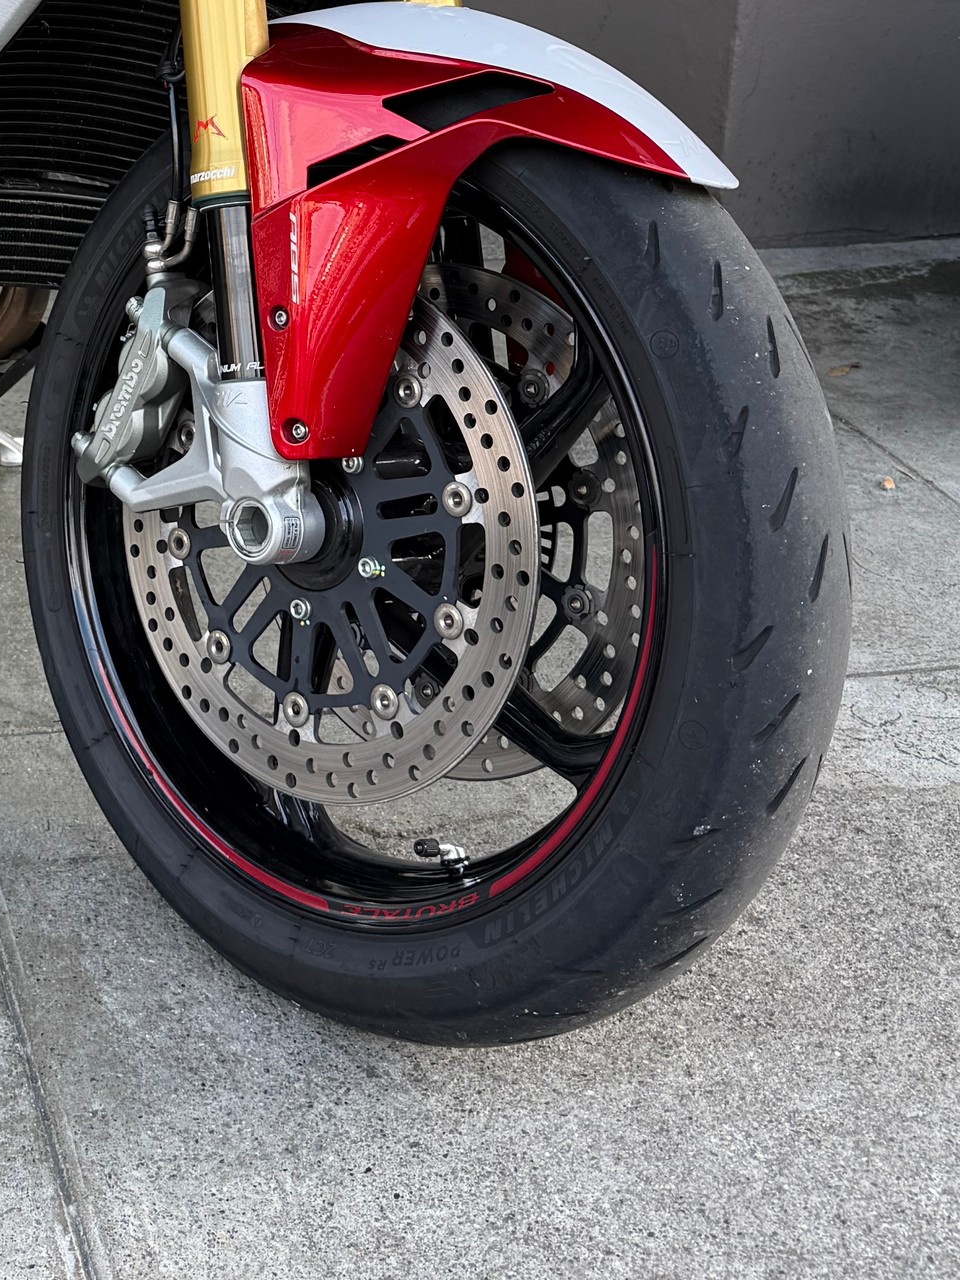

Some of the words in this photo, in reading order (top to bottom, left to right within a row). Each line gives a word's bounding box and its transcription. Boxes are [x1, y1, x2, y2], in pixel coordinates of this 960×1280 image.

[289, 211, 300, 305] ABS
[101, 358, 143, 440] brembo
[340, 892, 479, 920] BRUTALE
[483, 821, 613, 944] MICHELIN
[392, 945, 461, 967] POWER
